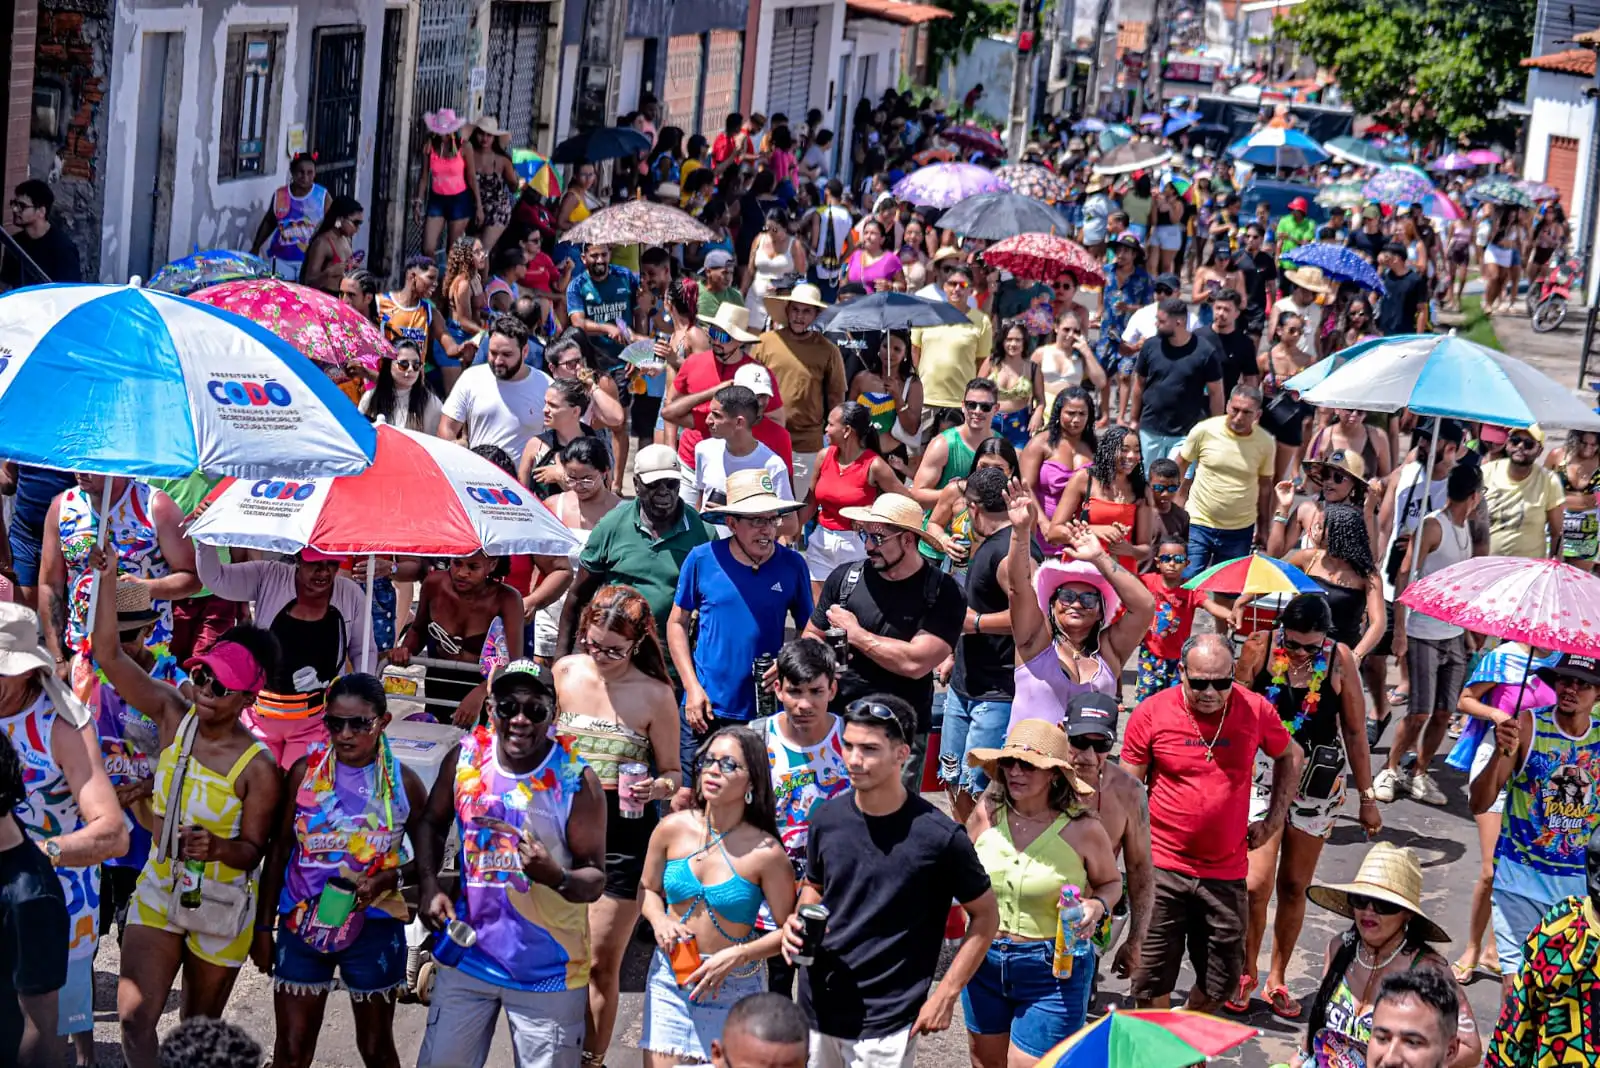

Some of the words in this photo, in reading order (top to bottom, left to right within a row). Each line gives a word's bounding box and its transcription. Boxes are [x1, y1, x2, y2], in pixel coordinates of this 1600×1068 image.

[586, 301, 627, 316] Emirates
[209, 371, 257, 379] PREFEITURA
[206, 378, 292, 407] CODÓ
[251, 479, 316, 501] CODÓ
